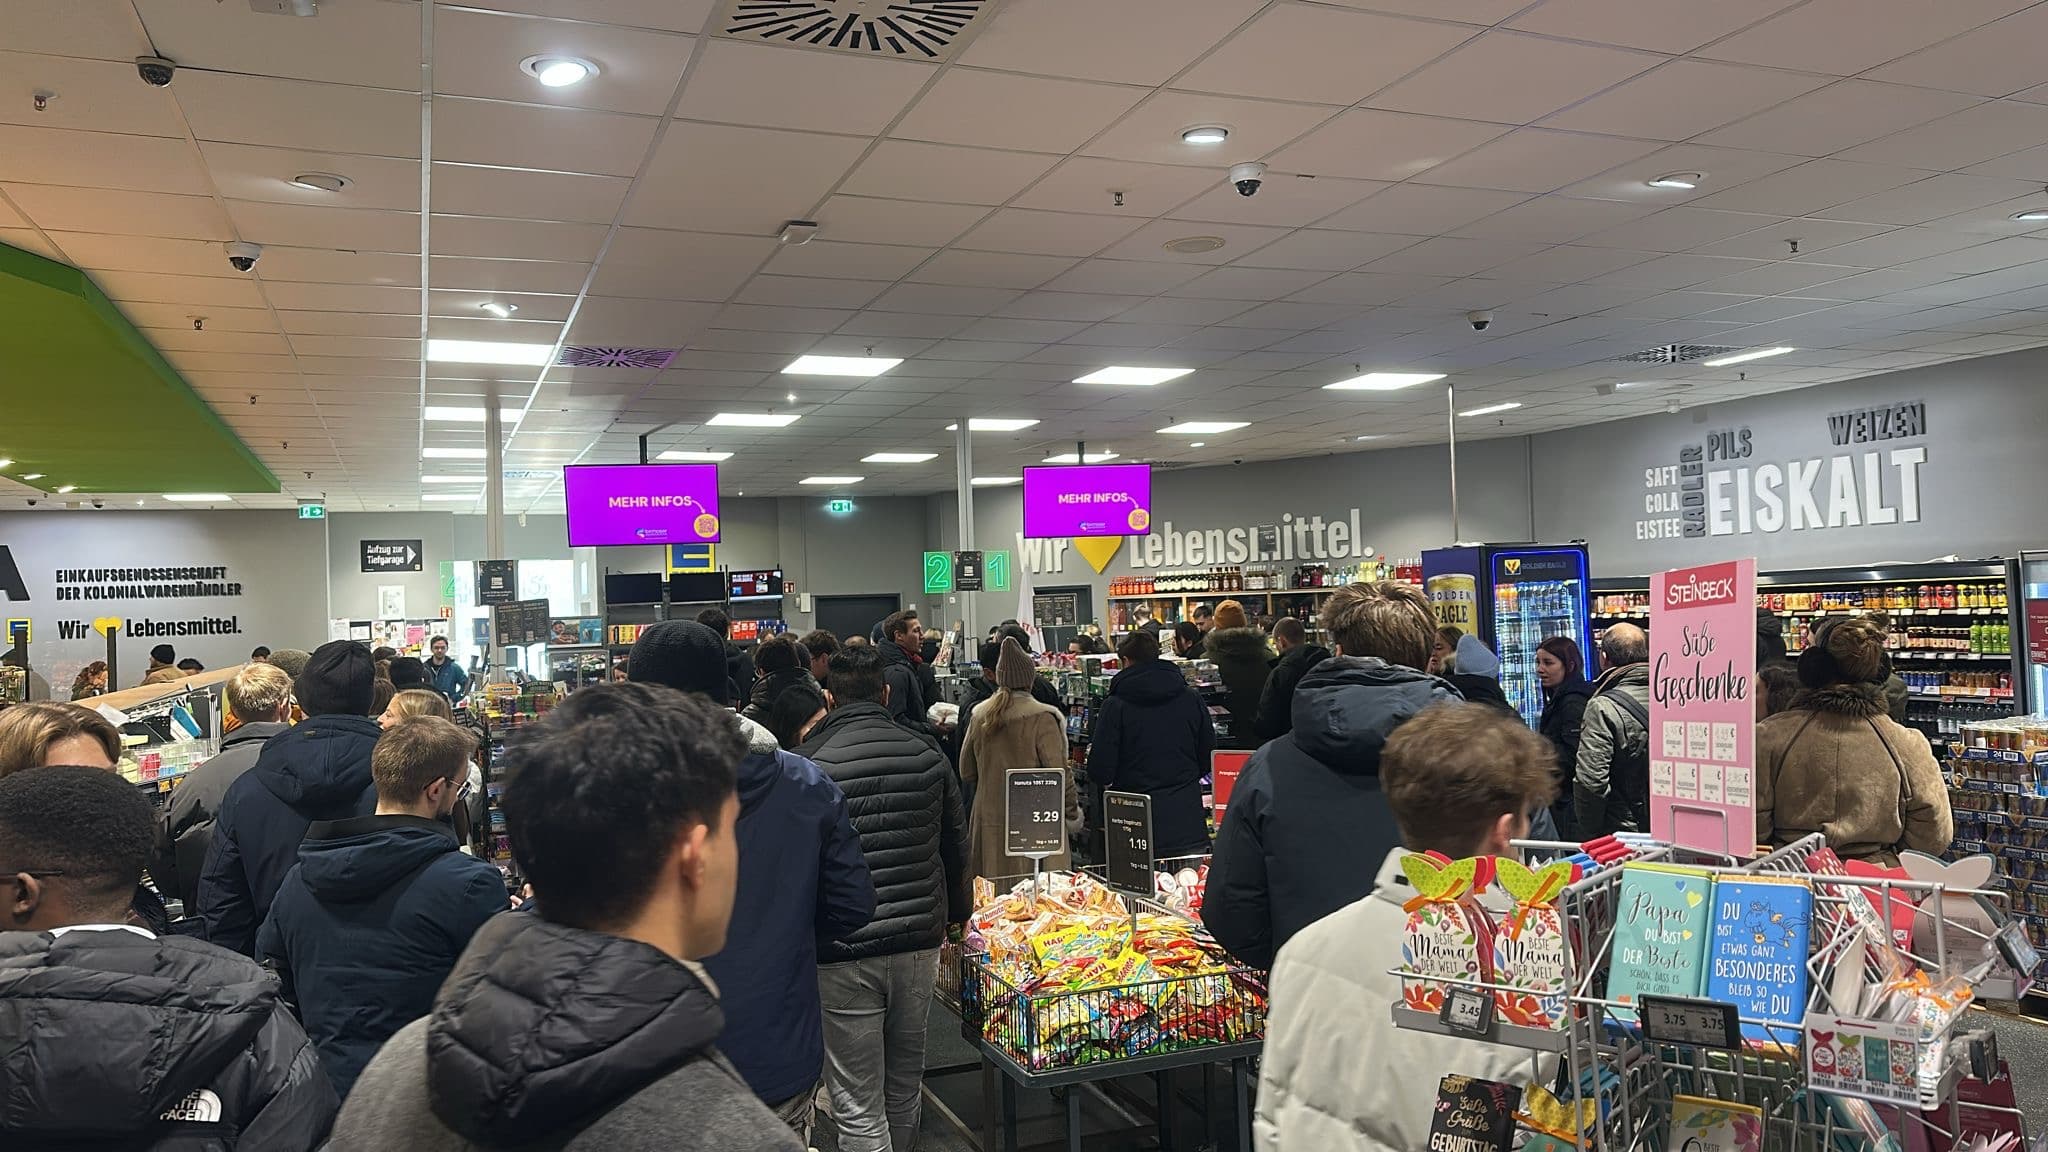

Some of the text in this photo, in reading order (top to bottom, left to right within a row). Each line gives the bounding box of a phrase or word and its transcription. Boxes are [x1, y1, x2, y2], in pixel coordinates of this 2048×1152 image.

[1827, 402, 1926, 445] WEIZEN
[1706, 428, 1752, 461] PILS
[1645, 465, 1678, 488] SAFT
[1058, 492, 1128, 504] MEHR INFOS
[1680, 445, 1706, 538] RADLER
[1708, 447, 1928, 536] EISKALT
[608, 495, 692, 508] MEHR INFOS
[1645, 491, 1679, 513] COLA
[1636, 518, 1681, 540] EISTEE
[367, 545, 404, 555] Aufzug zur
[367, 555, 404, 566] Tiefgarage
[55, 567, 227, 583] EINKAUFSGENOSSENSCHAFT
[927, 554, 949, 588] 2
[988, 554, 1004, 587] 1
[56, 581, 242, 601] DER KOLONIALWARENHÄNDLER
[1431, 591, 1472, 601] GOLDEN
[1666, 574, 1734, 605] STEINBECK
[1435, 605, 1468, 624] EAGLE
[57, 616, 242, 640] Wir Lebensmittel.
[1682, 621, 1716, 657] Süße
[1654, 652, 1748, 710] Geschenke
[1032, 811, 1059, 823] 3.29
[1129, 837, 1147, 850] 1.19
[1625, 884, 1690, 937] Papa
[1723, 902, 1740, 921] DU
[1434, 933, 1454, 946] BESTE
[1645, 927, 1682, 944] DU BIST
[1717, 923, 1733, 937] BIST
[1410, 934, 1469, 962] Mama
[1502, 938, 1564, 966] Mama
[1528, 937, 1550, 951] BESTE
[1721, 943, 1775, 958] ETWAS GANZ
[1420, 958, 1458, 974] DER WELT
[1623, 945, 1692, 970] DER Beste
[1513, 965, 1553, 979] DER WELT
[1654, 971, 1670, 982] DASS
[1671, 974, 1680, 985] ES
[1715, 958, 1796, 984] BESONDERES
[1728, 983, 1768, 998] BLEIB SO
[1751, 994, 1790, 1015] WIE DU
[1664, 1013, 1686, 1026] 3.75
[1701, 1017, 1725, 1030] 3.75
[1459, 1096, 1489, 1114] Süße
[1447, 1110, 1491, 1132] Grüße
